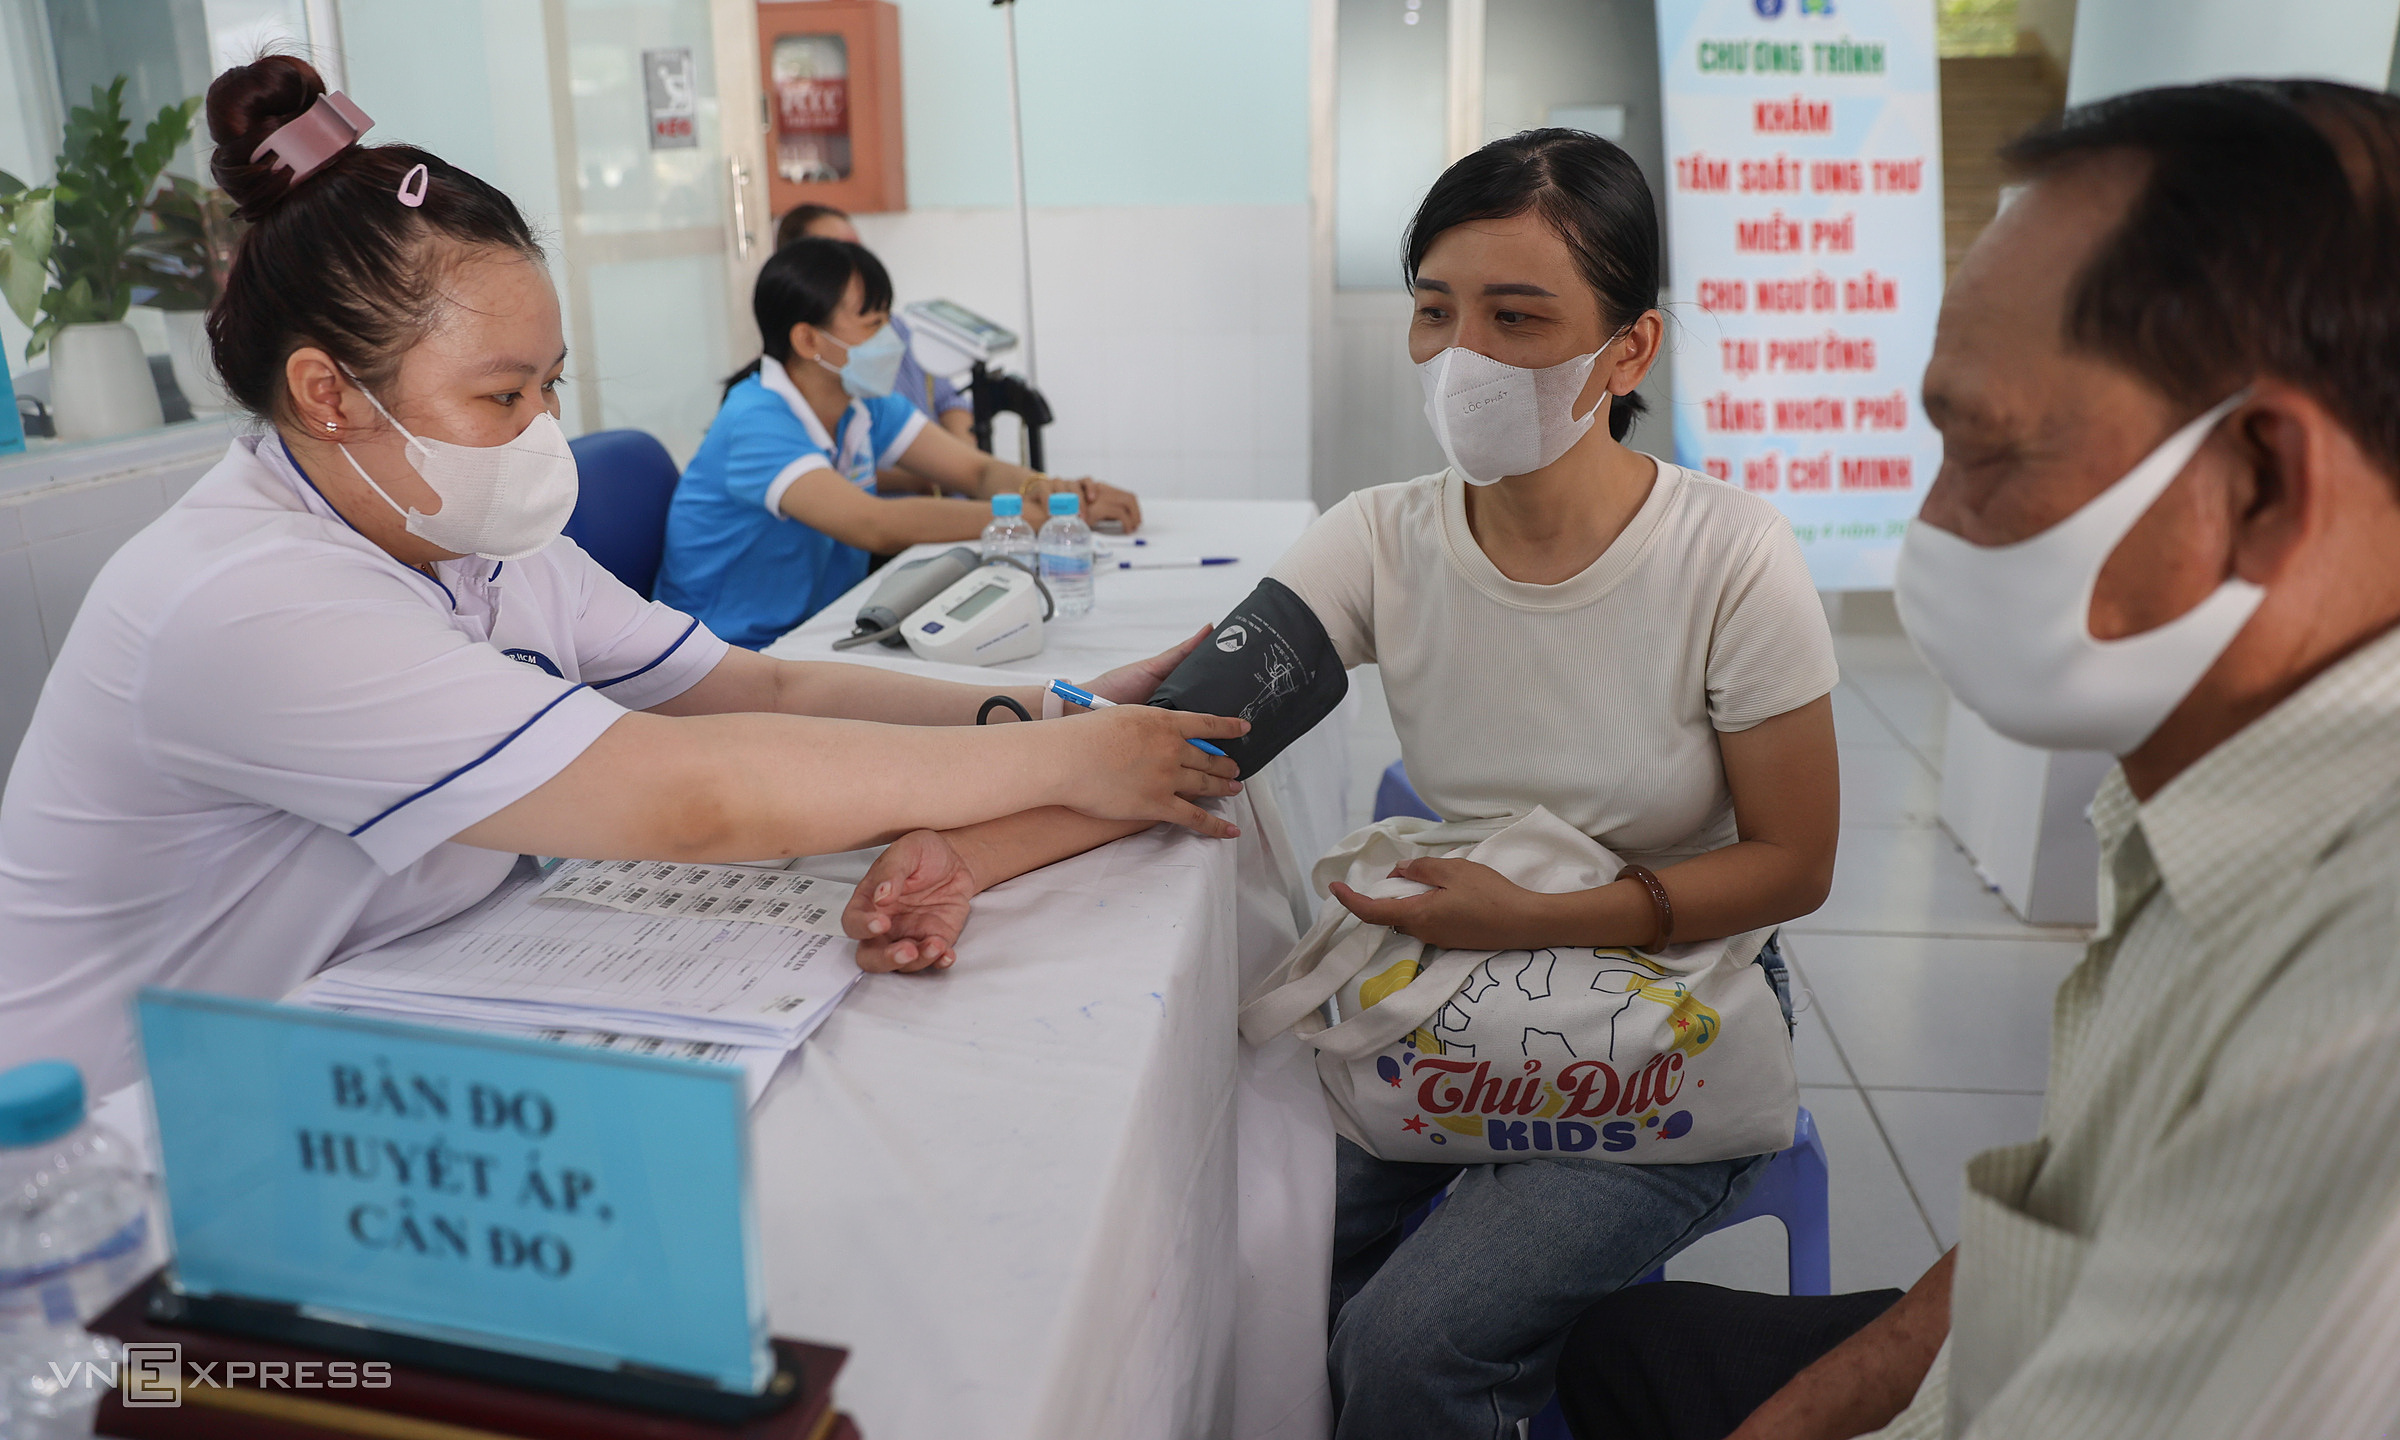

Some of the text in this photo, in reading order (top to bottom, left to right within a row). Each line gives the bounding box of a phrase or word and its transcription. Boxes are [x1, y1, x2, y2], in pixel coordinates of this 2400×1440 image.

[1812, 34, 1885, 74] TRÌNH
[1754, 92, 1832, 134] KHÁM
[1739, 151, 1803, 193] SOÁT
[1871, 155, 1925, 193] THƯ
[1811, 211, 1854, 254] PHÍ
[1698, 269, 1898, 312] CHO NGƯỜI DÂN
[1720, 330, 1876, 381] TẠI PHƯỜNG
[1704, 391, 1766, 433] TĂNG
[1854, 388, 1908, 433] PHÚ
[1787, 450, 1831, 492] CHÍ
[1839, 456, 1913, 492] MINH
[331, 1055, 557, 1139] BÀN ĐO
[1413, 1052, 1685, 1120] Thủ Đức
[1487, 1118, 1637, 1152] KIDS
[297, 1127, 615, 1224] HUYẾT ÁP,
[348, 1197, 574, 1280] CÂN ĐO
